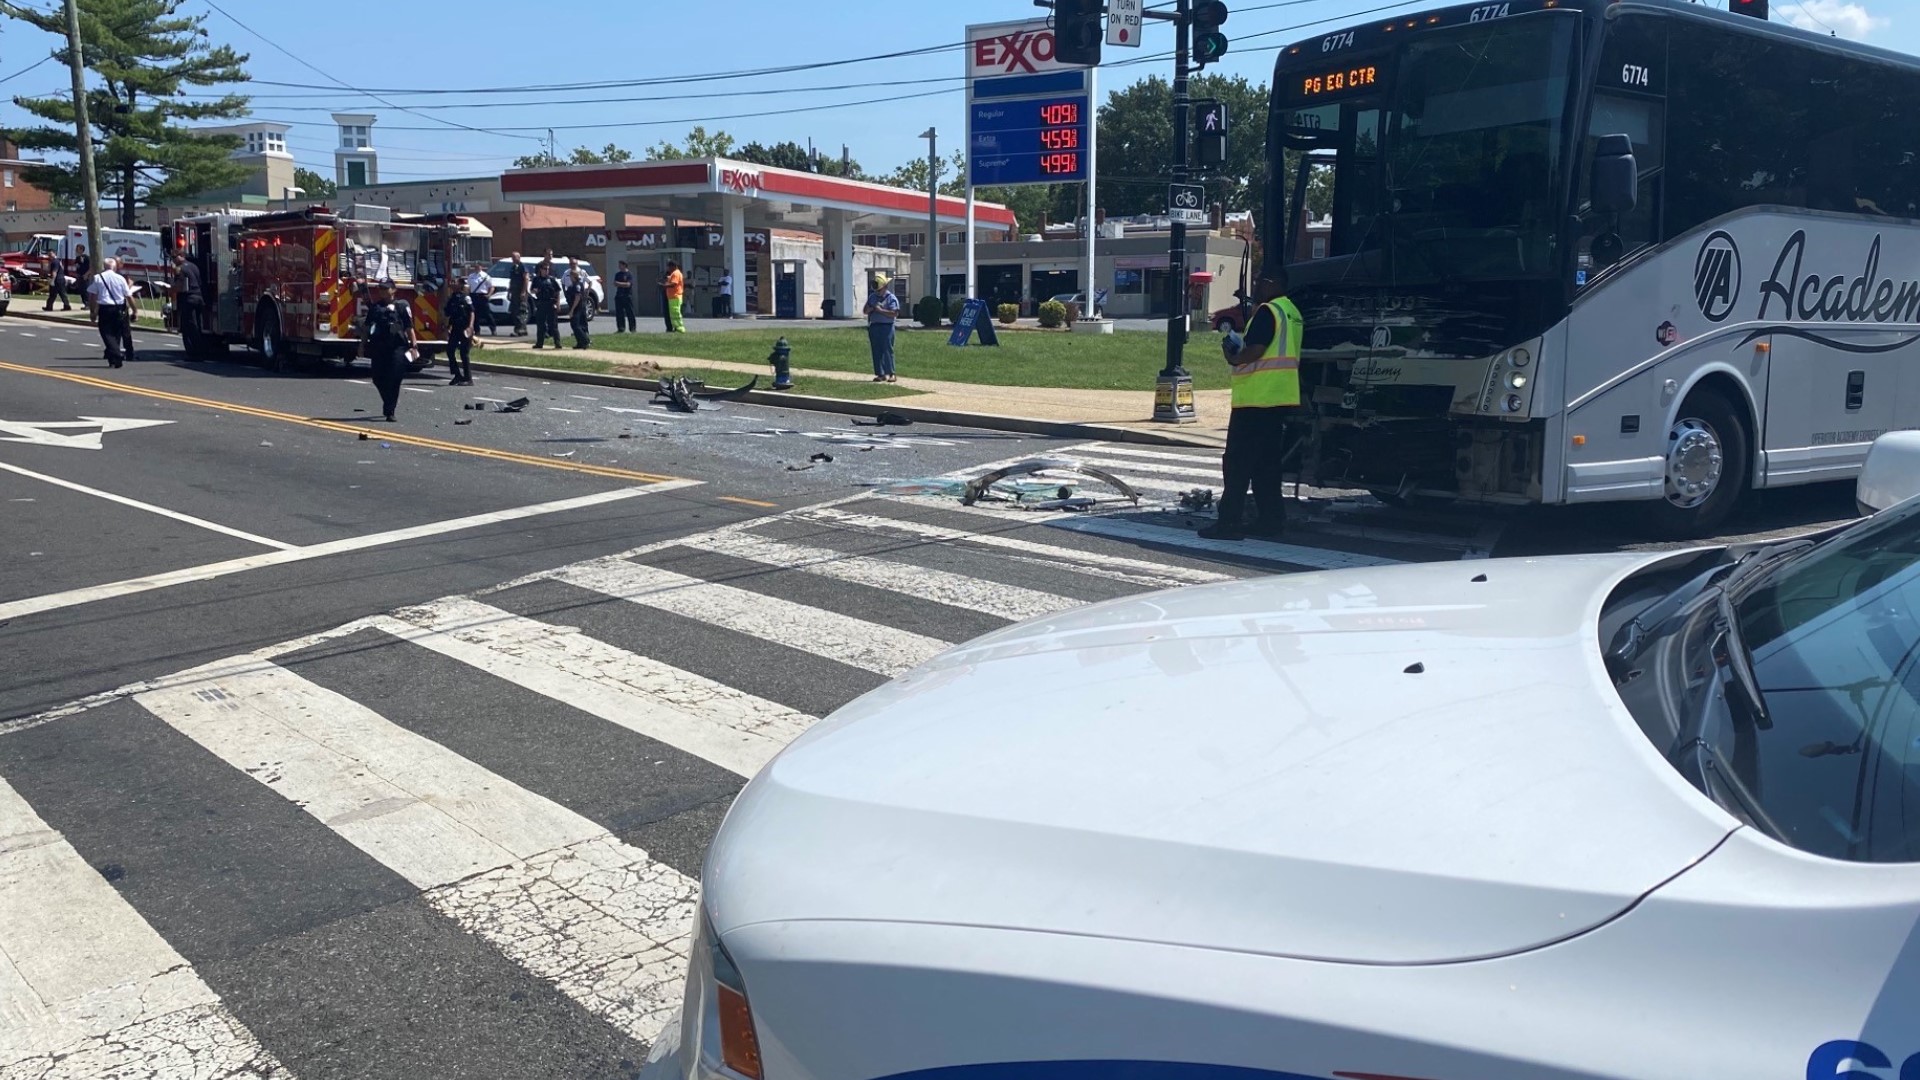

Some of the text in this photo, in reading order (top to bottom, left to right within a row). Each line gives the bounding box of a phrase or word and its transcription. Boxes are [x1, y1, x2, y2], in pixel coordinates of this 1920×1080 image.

[1116, 0, 1136, 10] TURN
[1470, 2, 1510, 23] 6774
[1110, 13, 1139, 26] ON RED
[1322, 32, 1355, 52] 6774
[976, 31, 1056, 74] EXXO
[1304, 67, 1375, 95] PG EQ CTR
[1622, 63, 1649, 87] 6774
[978, 109, 1005, 121] Regular
[978, 135, 997, 143] Extra
[722, 169, 762, 194] EXXON
[1171, 209, 1202, 221] BIKE LANE
